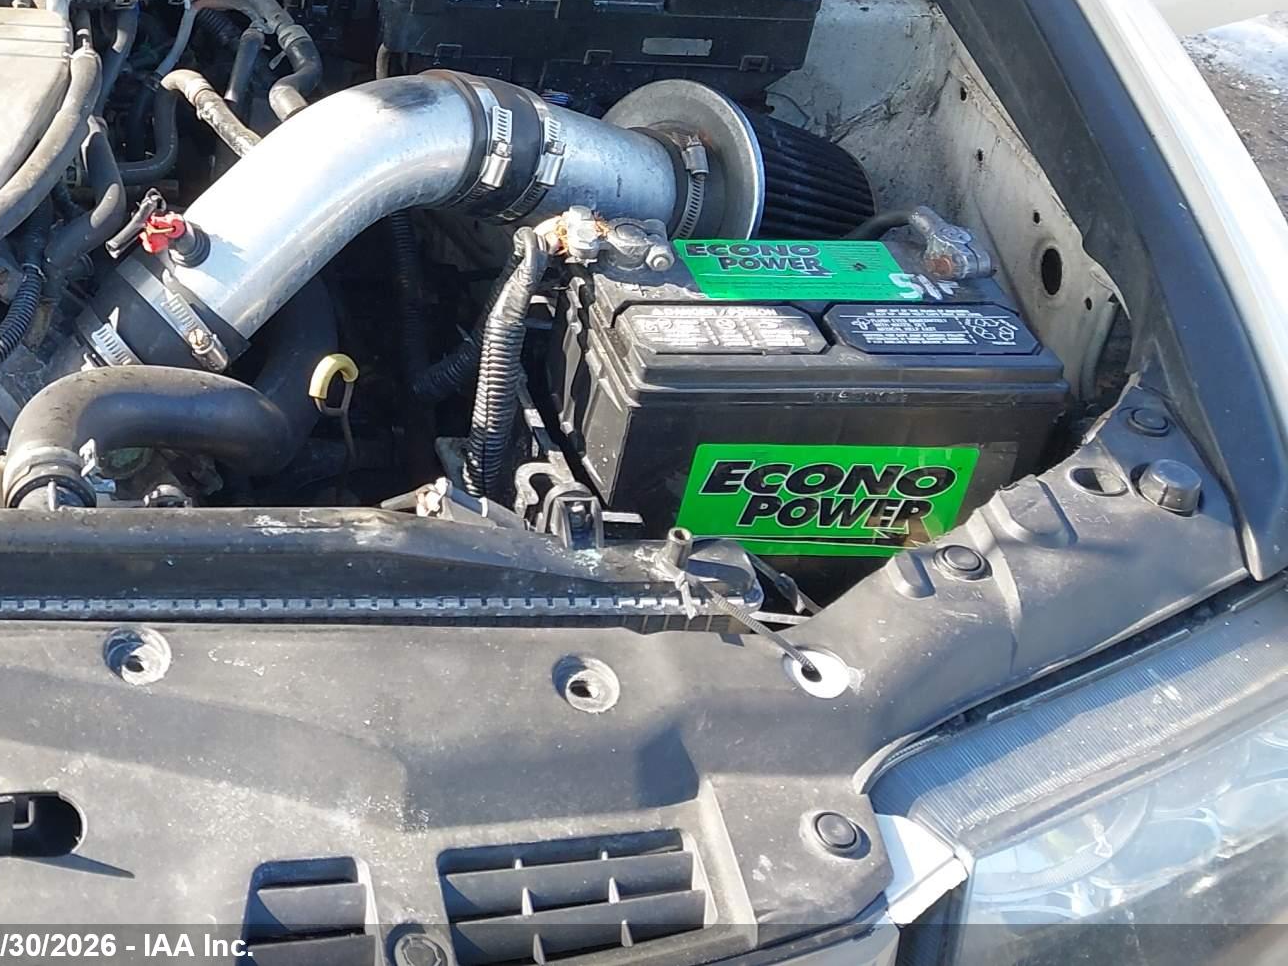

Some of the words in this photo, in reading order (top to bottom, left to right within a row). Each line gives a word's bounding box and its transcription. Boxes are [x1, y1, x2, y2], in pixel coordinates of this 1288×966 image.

[685, 243, 821, 258] ECONO
[718, 256, 827, 274] POWER
[699, 461, 957, 497] ECONO
[737, 496, 936, 533] POWER
